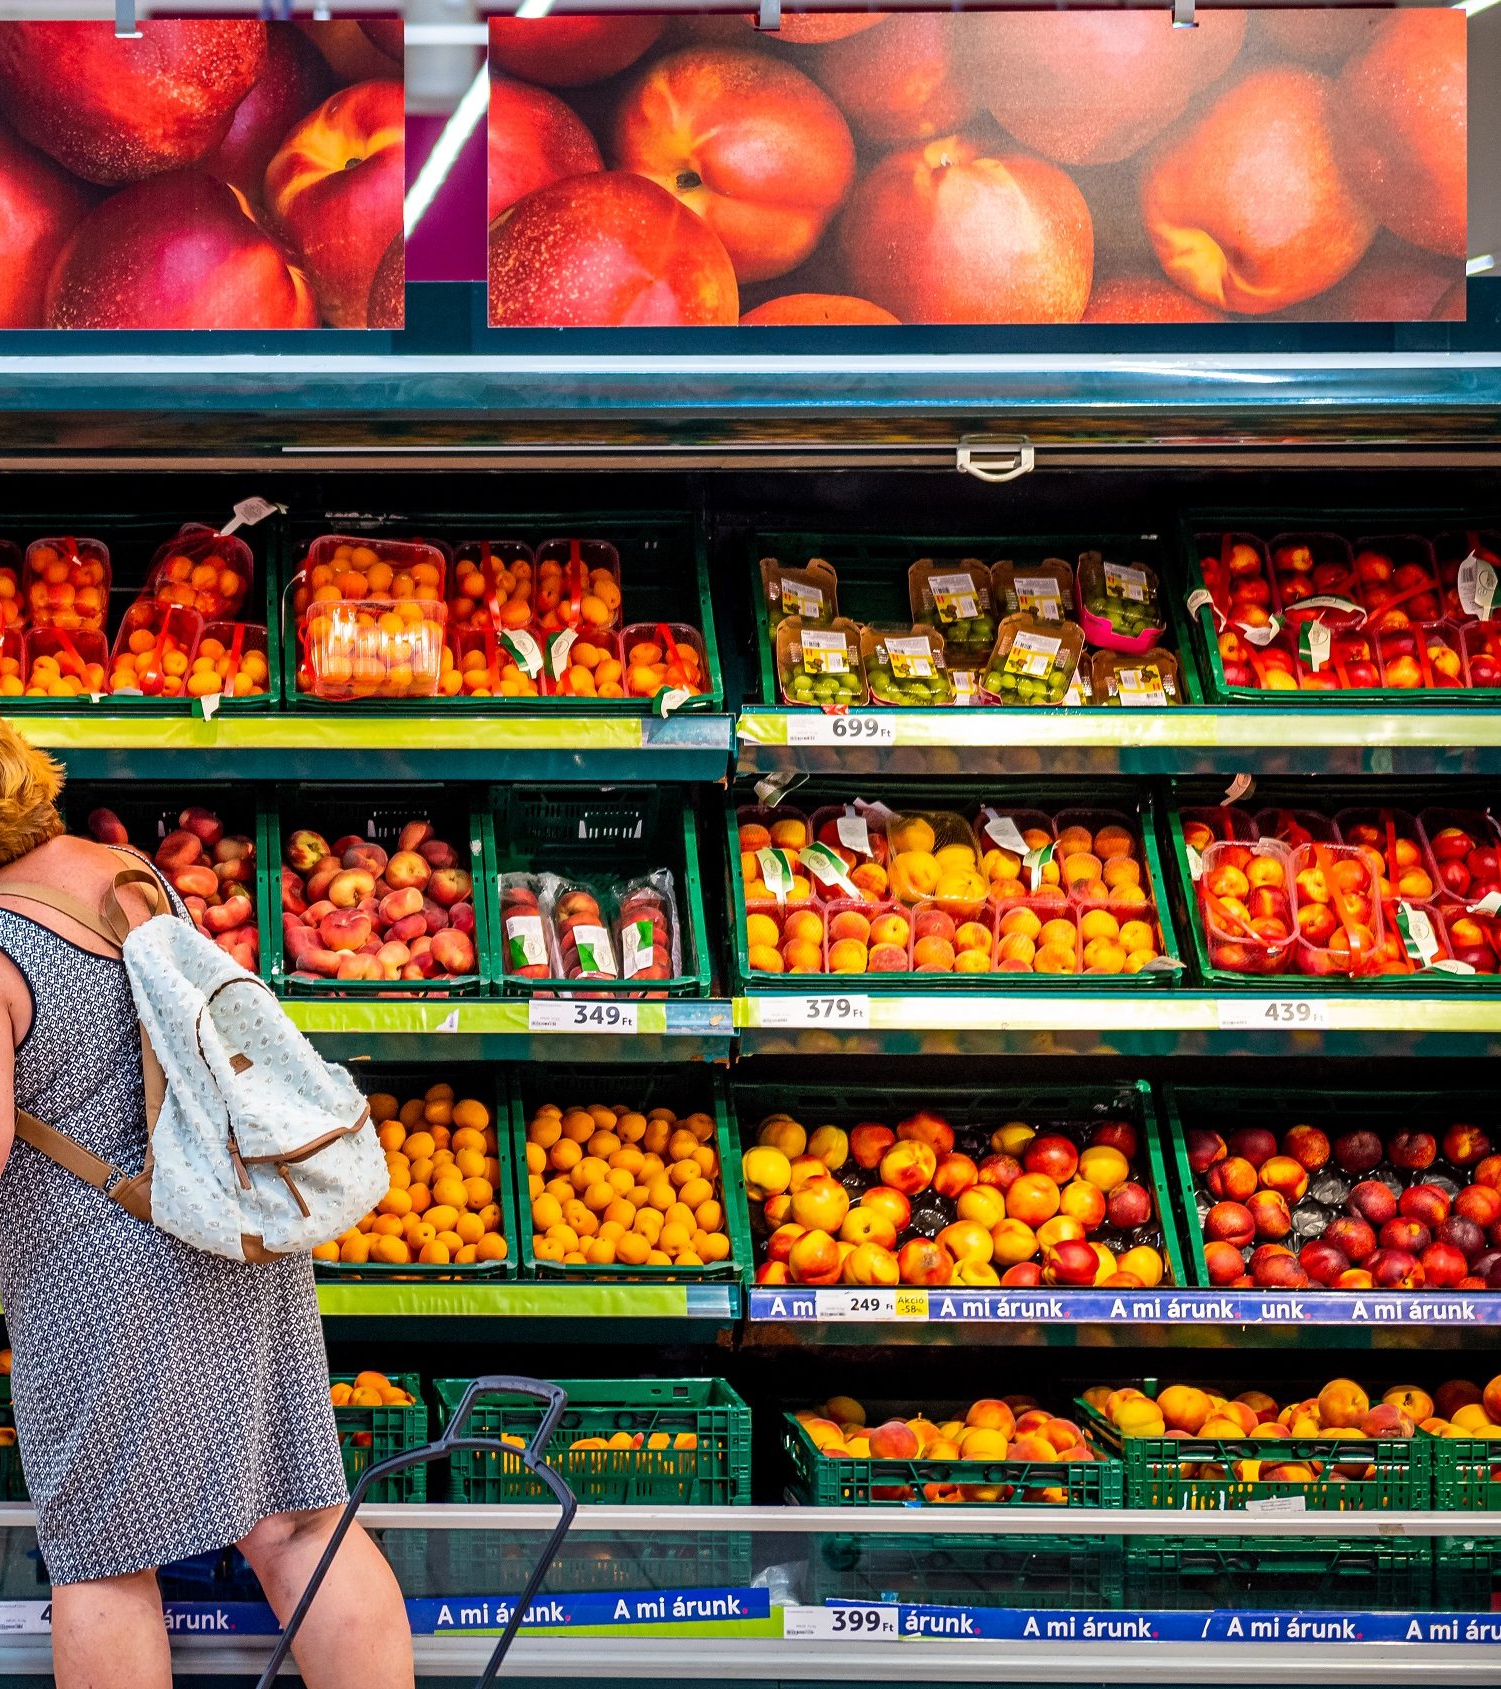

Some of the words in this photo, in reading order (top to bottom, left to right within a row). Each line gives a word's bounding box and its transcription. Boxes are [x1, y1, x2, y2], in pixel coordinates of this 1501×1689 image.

[832, 718, 879, 737] 699
[881, 729, 891, 737] Ft
[573, 1005, 620, 1025] 349
[622, 1018, 632, 1026] Ft
[806, 998, 851, 1018] 379
[853, 1009, 863, 1017] Ft
[1265, 1003, 1311, 1021] 439
[1313, 1014, 1323, 1022] Ft
[770, 1297, 787, 1316] A
[850, 1298, 880, 1311] 249
[898, 1296, 924, 1304] Akció
[940, 1298, 956, 1317] A
[962, 1298, 990, 1317] mi
[997, 1298, 1071, 1318] árunk.
[1111, 1298, 1127, 1317] A
[1133, 1298, 1160, 1317] mi
[1167, 1298, 1241, 1319] árunk.
[1352, 1300, 1368, 1319] A
[1374, 1300, 1401, 1319] mi
[1409, 1300, 1483, 1320] árunk.
[437, 1604, 454, 1625] A
[460, 1603, 489, 1624] mi
[613, 1599, 631, 1619] A
[637, 1597, 665, 1618] mi
[672, 1595, 748, 1617] árunk.
[832, 1610, 881, 1632] 399
[883, 1623, 894, 1632] Ft
[905, 1610, 981, 1635] árunk.
[1023, 1616, 1040, 1637] A
[1047, 1616, 1076, 1637] mi
[1082, 1616, 1159, 1638] árunk.
[1227, 1617, 1244, 1637] A
[1251, 1617, 1279, 1637] mi
[1287, 1618, 1363, 1639] árunk.
[1405, 1619, 1422, 1640] A
[1429, 1619, 1458, 1640] mi
